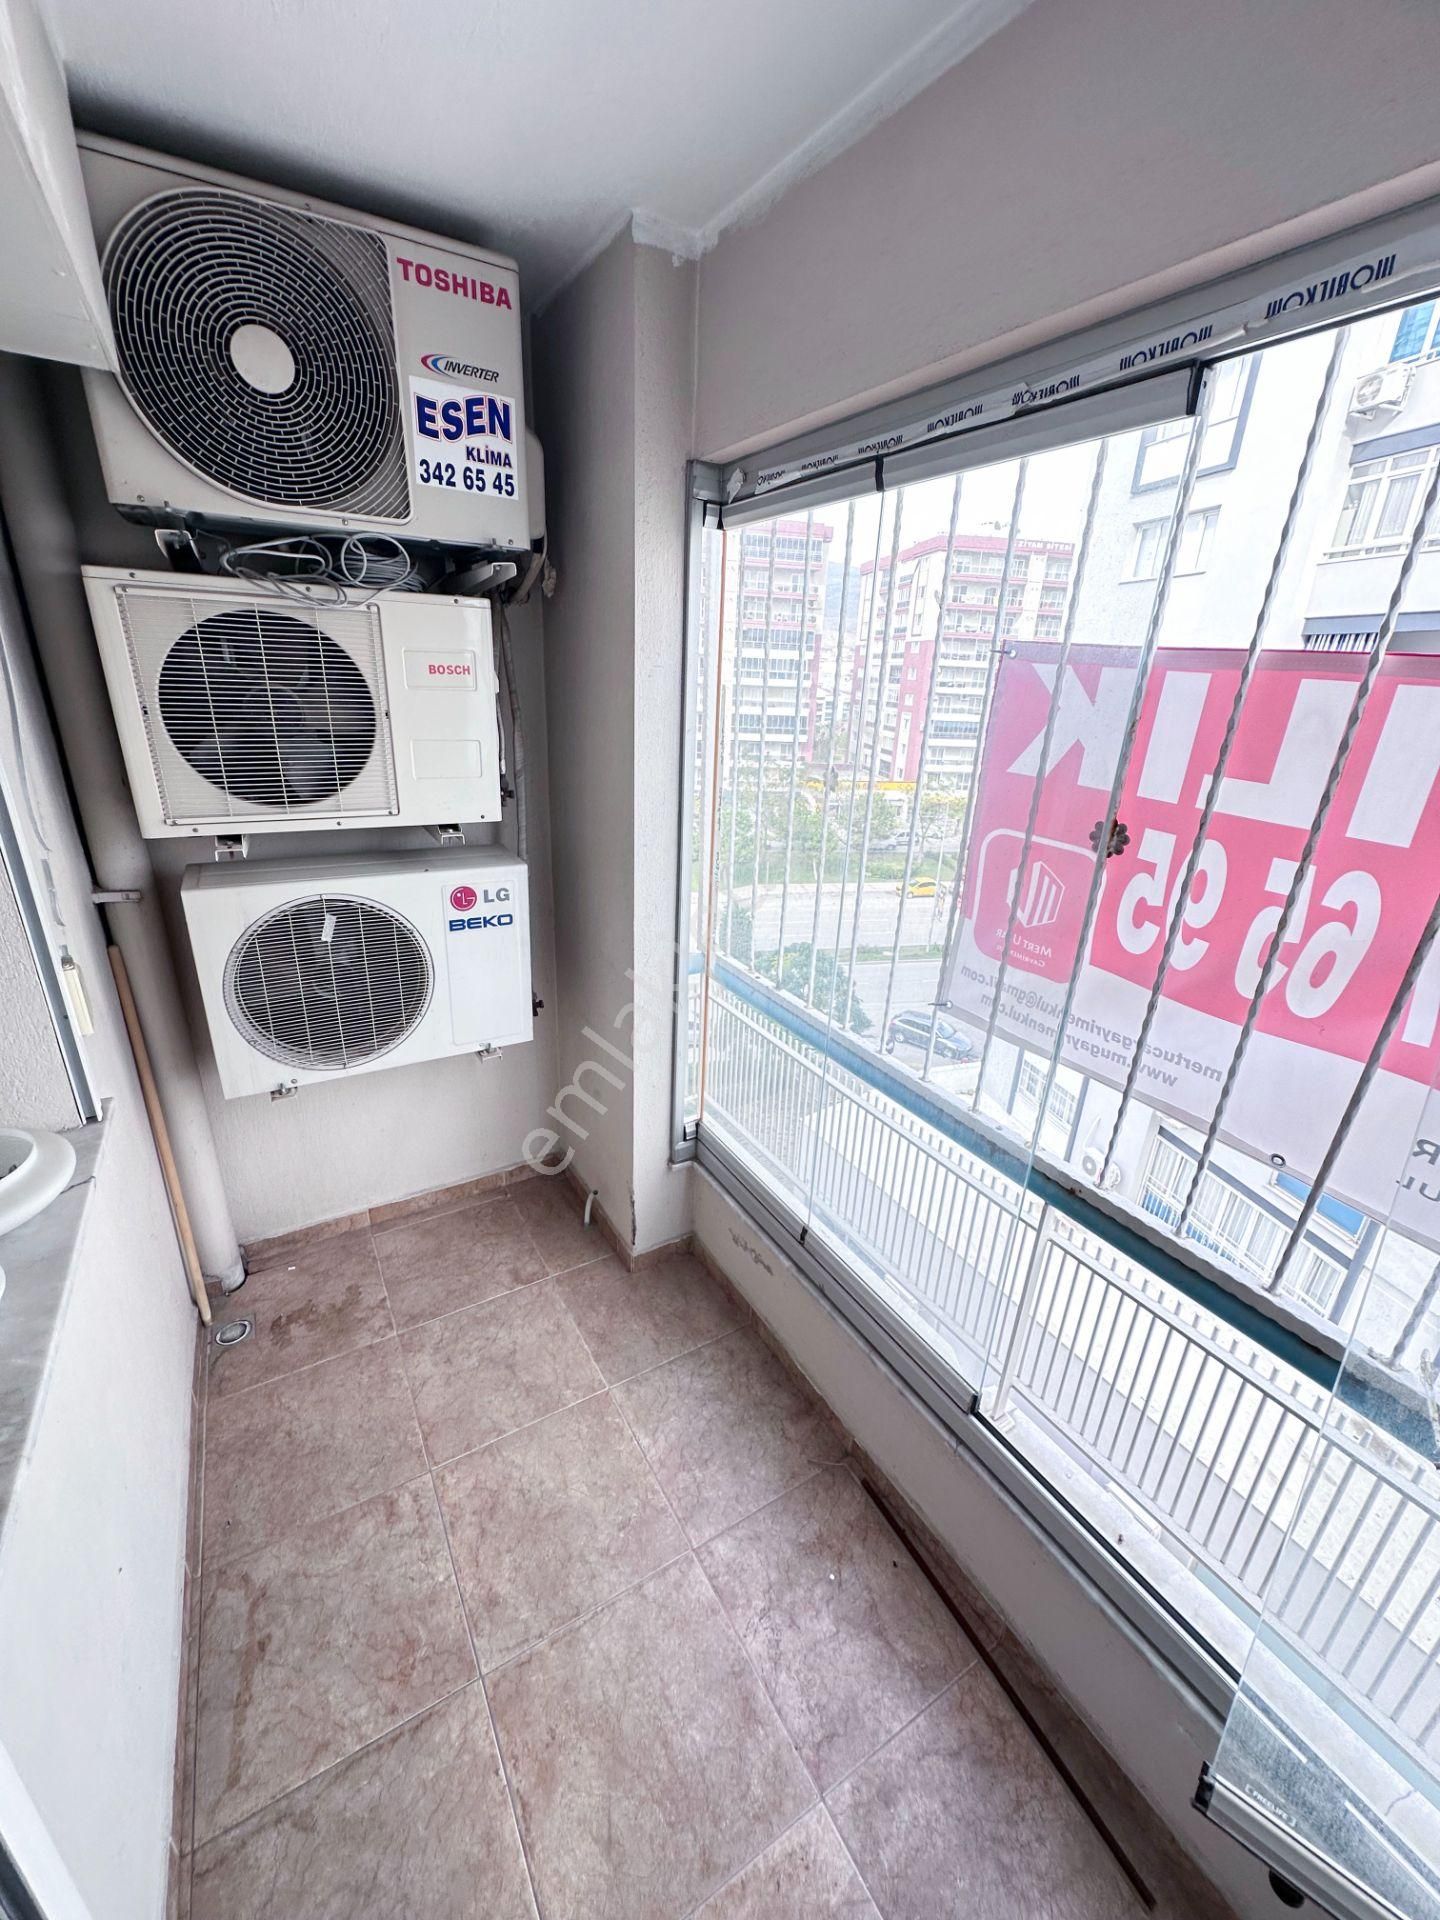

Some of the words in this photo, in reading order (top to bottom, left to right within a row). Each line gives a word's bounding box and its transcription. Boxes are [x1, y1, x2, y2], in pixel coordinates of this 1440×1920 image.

[397, 257, 512, 310] TOSHIBA
[444, 360, 499, 383] INVERTER
[415, 393, 512, 443] ESEN
[465, 445, 513, 468] KLİMA
[420, 459, 456, 487] 342
[463, 466, 486, 492] 65
[492, 473, 515, 497] 45
[428, 664, 471, 676] BOSCH
[483, 887, 511, 903] LG
[448, 913, 514, 932] BEKO
